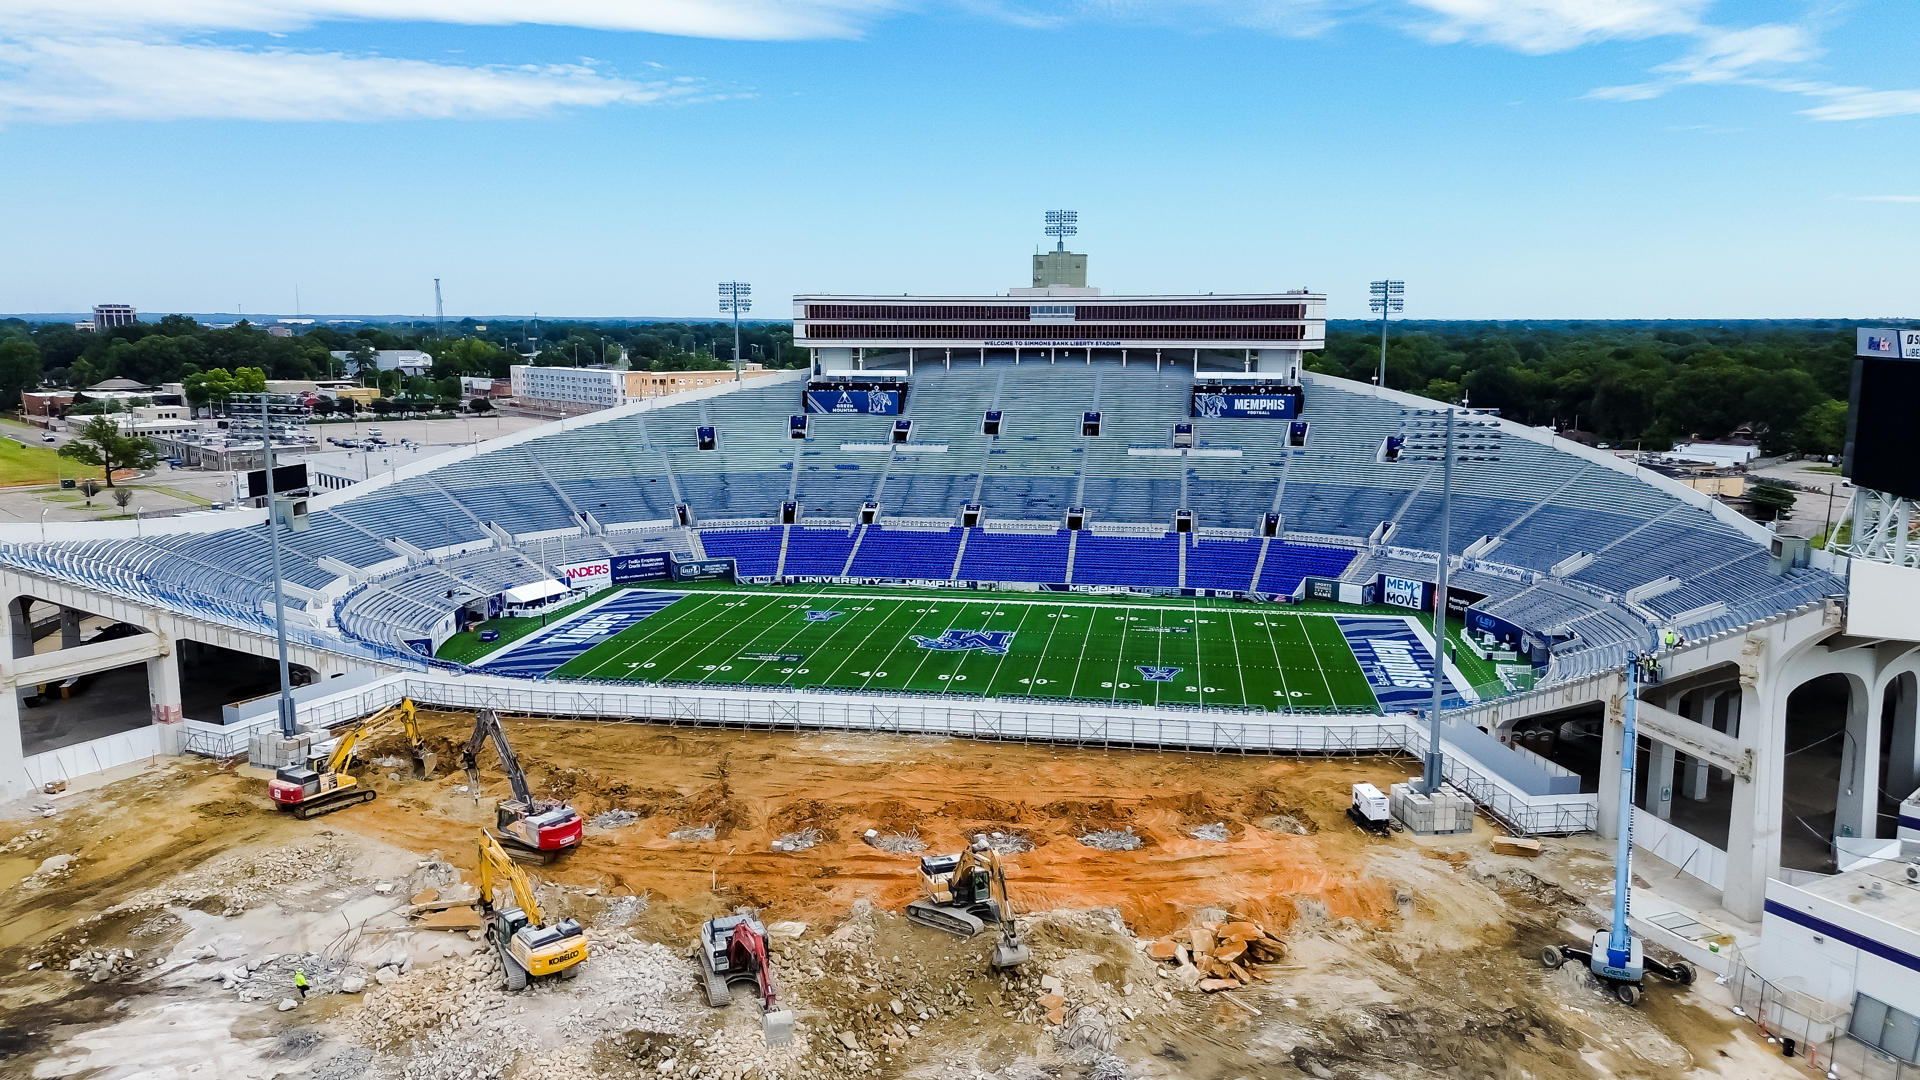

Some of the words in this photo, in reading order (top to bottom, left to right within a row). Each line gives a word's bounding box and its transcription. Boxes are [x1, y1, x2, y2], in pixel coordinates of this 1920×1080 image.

[1867, 336, 1891, 351] FedEx
[1234, 398, 1285, 410] MEMPHIS
[565, 564, 609, 579] ANDERS
[799, 576, 881, 585] UNIVERSITY
[905, 579, 967, 588] MEMPHIS
[1387, 578, 1414, 591] MEM
[1069, 584, 1130, 593] MEMPHIS
[1132, 587, 1182, 596] TIGERS
[1386, 592, 1419, 607] MOVE
[1449, 596, 1470, 605] Memphis
[548, 950, 580, 966] KOBELCO
[1602, 966, 1631, 978] Genie
